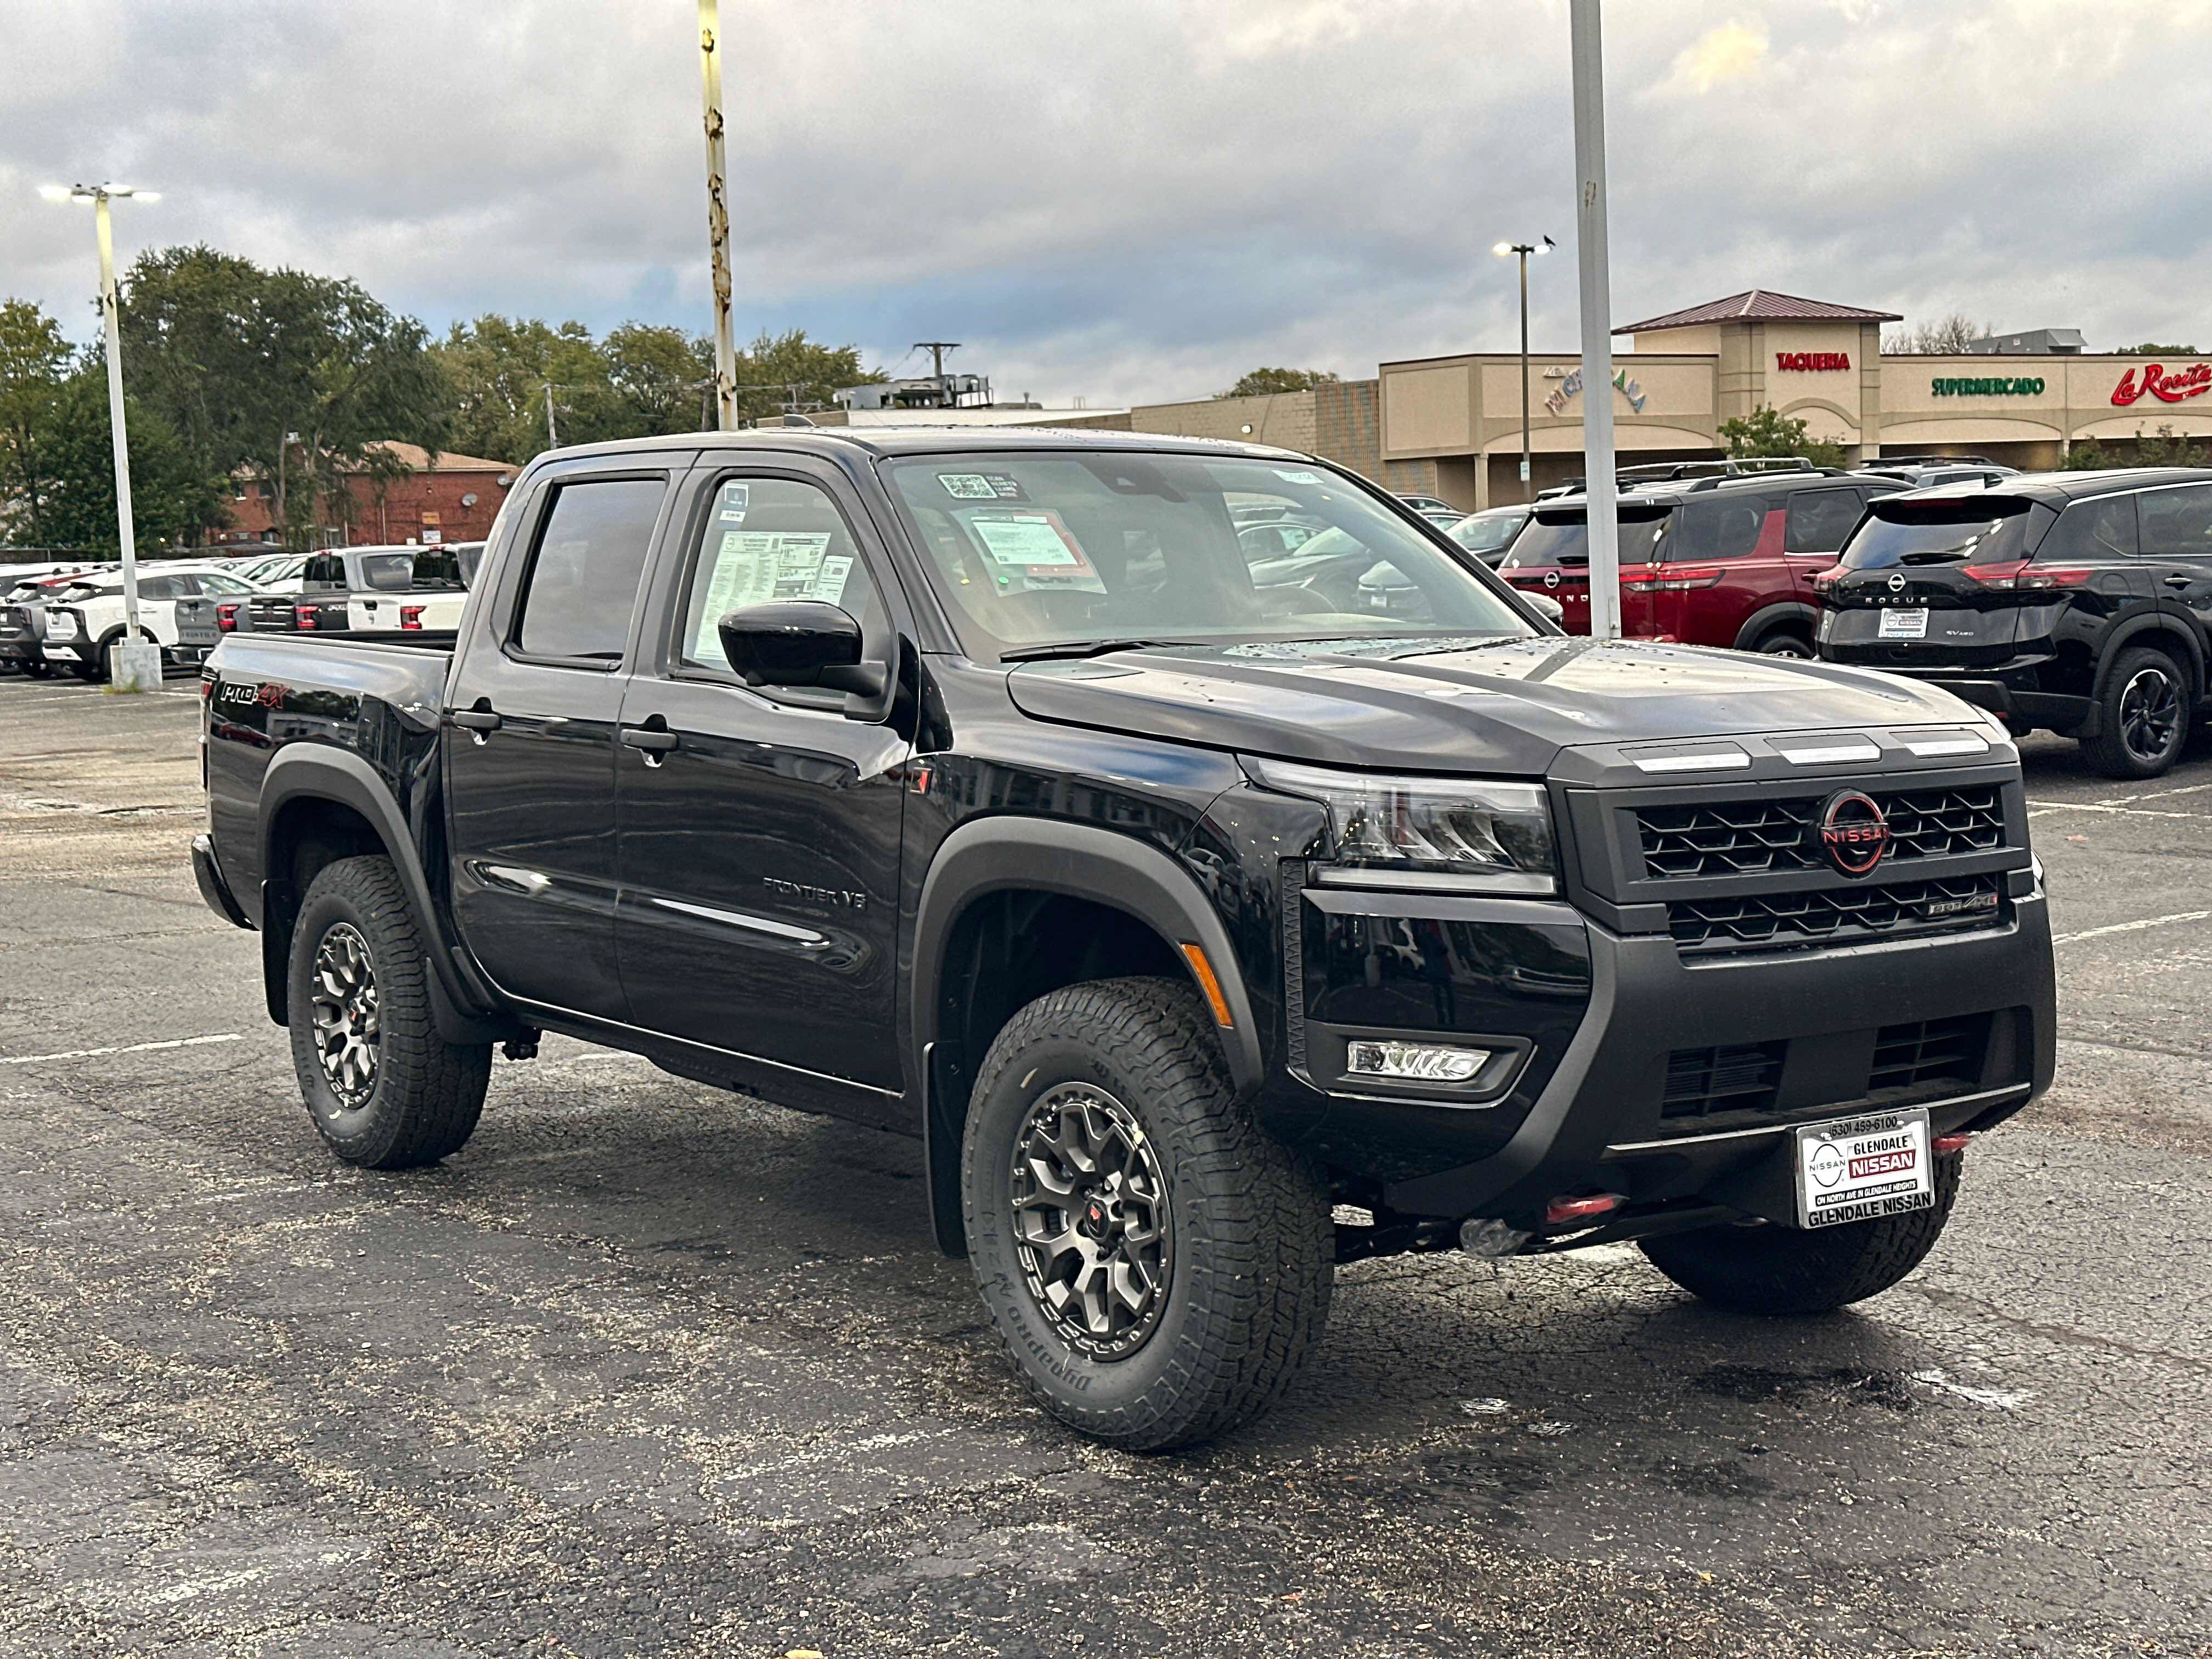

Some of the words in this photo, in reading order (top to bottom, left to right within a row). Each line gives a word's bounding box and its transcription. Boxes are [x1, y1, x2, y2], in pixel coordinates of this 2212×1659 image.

[1776, 352, 1851, 371] TAQUERIA
[1932, 377, 2045, 396] SUPERMERCADO
[2111, 368, 2138, 405] La
[2136, 363, 2212, 402] Rosita
[1823, 825, 1891, 843] NISSAN
[763, 877, 838, 905] FRONTIER
[1829, 1124, 1852, 1137] (630)
[1854, 1115, 1898, 1132] 469-6100
[1854, 1135, 1909, 1155] GLENDALE
[1809, 1159, 1846, 1172] NISSAN
[1851, 1152, 1914, 1176] NISSAN
[1817, 1195, 1826, 1205] ON
[1826, 1192, 1846, 1204] NORTH
[1846, 1190, 1858, 1200] AVE
[1858, 1189, 1864, 1198] IN
[1864, 1184, 1892, 1197] GLENDALE
[1893, 1180, 1916, 1192] HEIGHTS
[1808, 1201, 1880, 1227] GLENDALE
[1883, 1192, 1932, 1214] NISSAN
